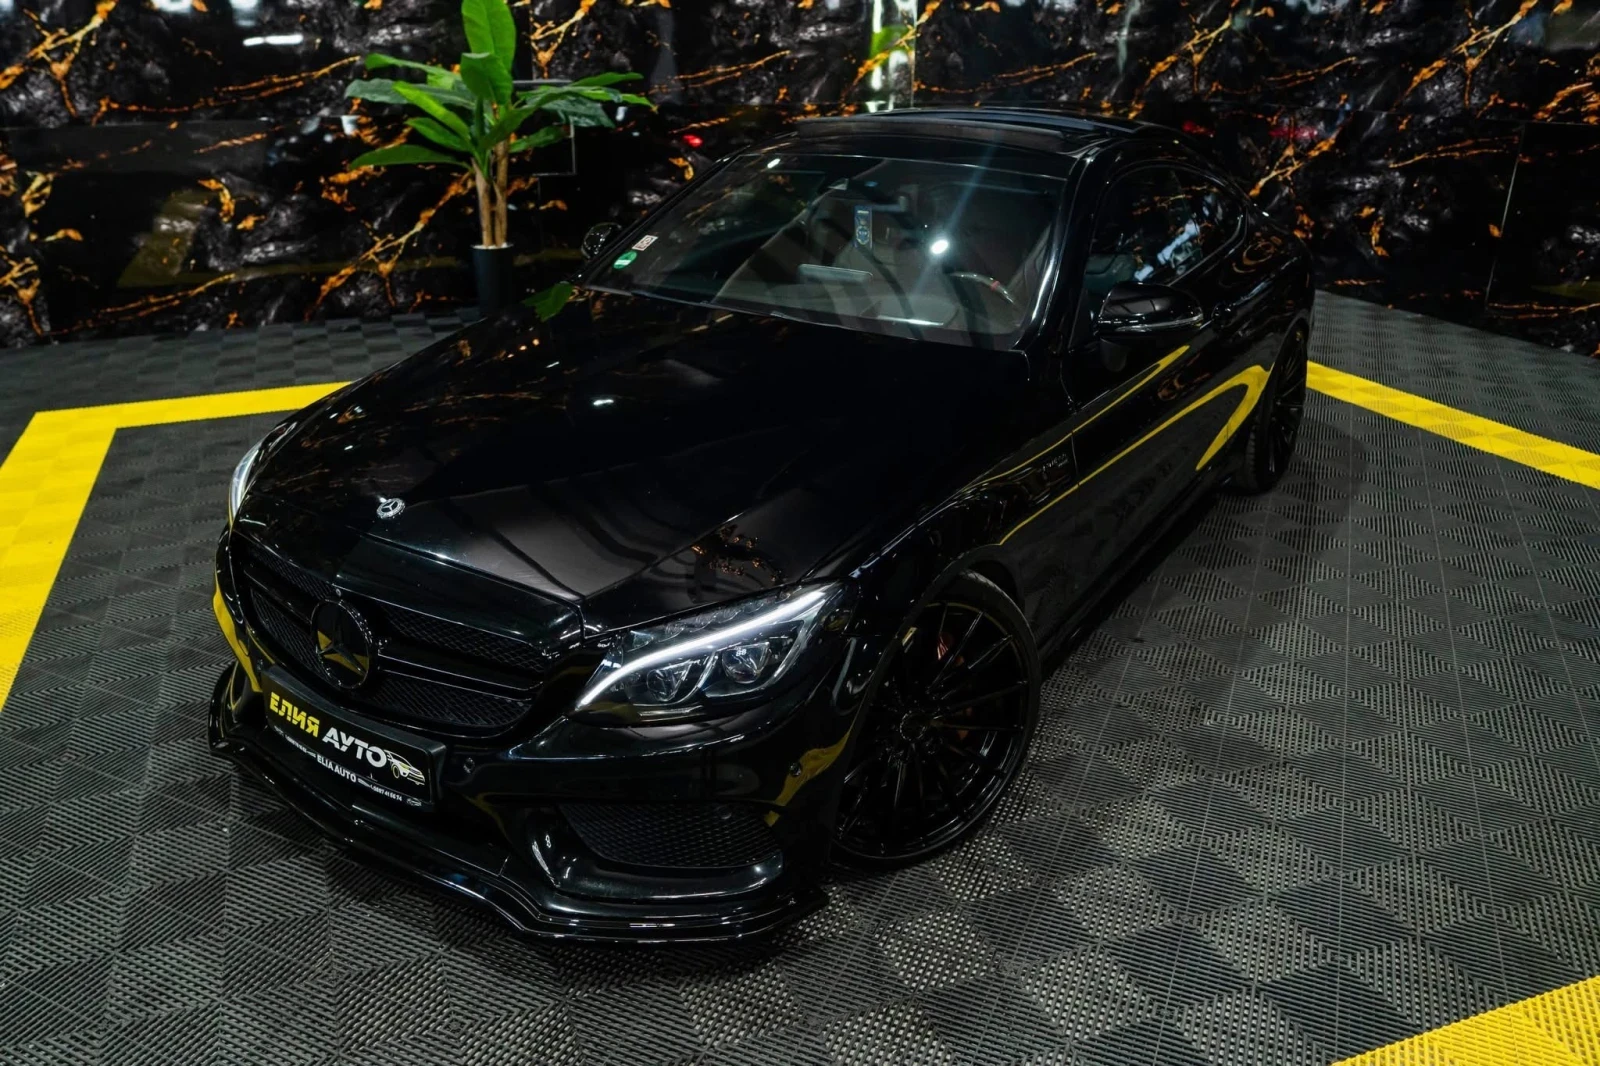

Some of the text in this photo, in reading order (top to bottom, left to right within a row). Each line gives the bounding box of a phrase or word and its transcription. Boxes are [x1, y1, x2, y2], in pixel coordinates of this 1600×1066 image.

[269, 691, 320, 738] ЕЛИЯ
[321, 726, 388, 768] АУТО
[316, 753, 357, 783] ELIA AUTO
